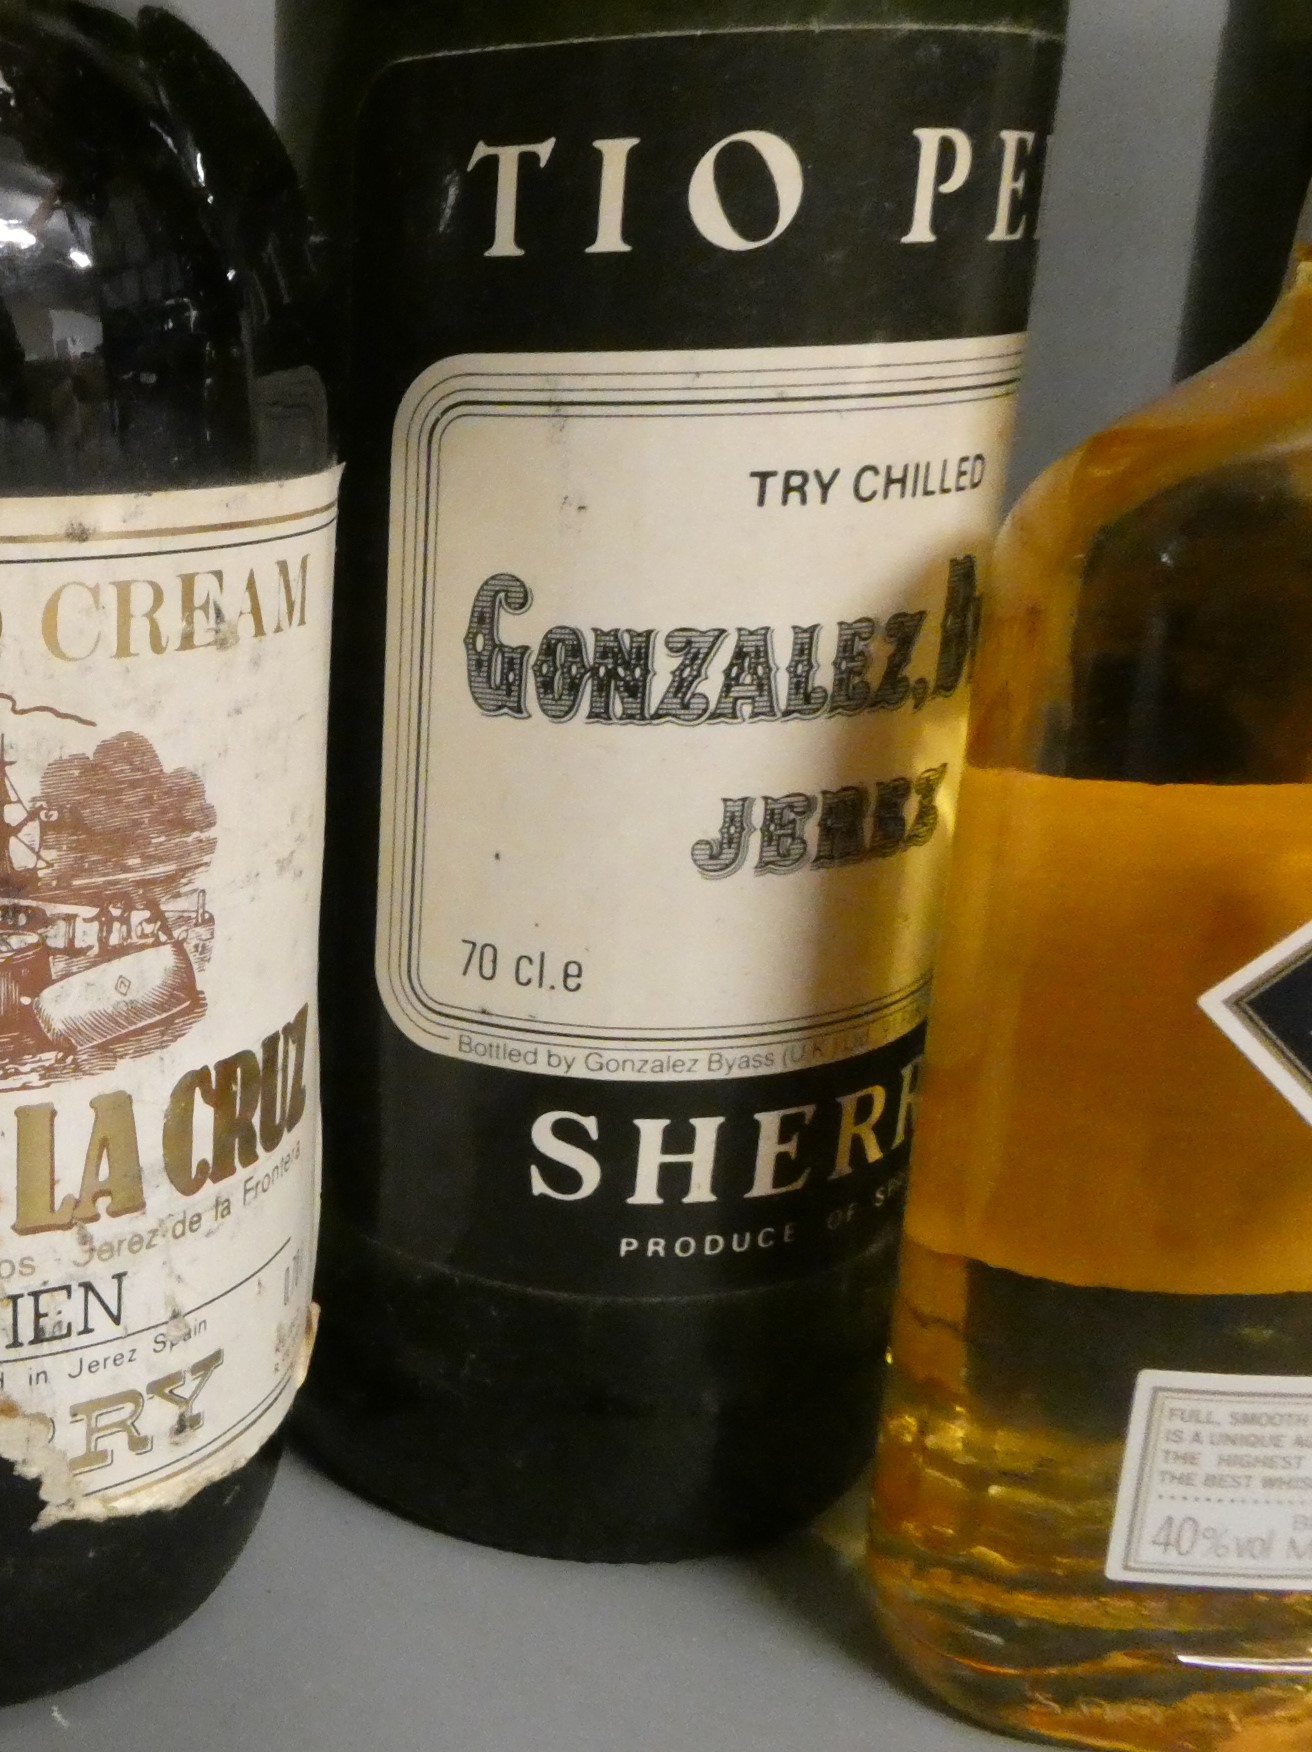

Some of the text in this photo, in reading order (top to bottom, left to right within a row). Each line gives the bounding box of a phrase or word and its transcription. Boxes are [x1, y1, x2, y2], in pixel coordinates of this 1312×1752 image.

[466, 126, 1040, 258] TIO PE
[749, 453, 985, 508] TRY CHILLED
[40, 552, 312, 663] CREAM
[461, 939, 498, 981] 70
[458, 1034, 538, 1065] Bottled
[547, 1049, 576, 1073] by
[587, 1053, 699, 1073] Gonzalez
[707, 1049, 775, 1075] Byass
[14, 1090, 148, 1235] LA
[162, 1002, 308, 1197] CRUZ
[172, 1210, 202, 1240] de
[215, 1195, 232, 1222] la
[243, 1140, 301, 1207] Frontera
[620, 1221, 795, 1257] PRODUCE
[828, 1202, 857, 1230] OF
[28, 1366, 48, 1387] in
[68, 1347, 138, 1380] Jerez
[1161, 1449, 1201, 1466] THE
[1190, 1431, 1203, 1445] A
[1158, 1470, 1198, 1487] THE
[1203, 1473, 1253, 1489] BEST
